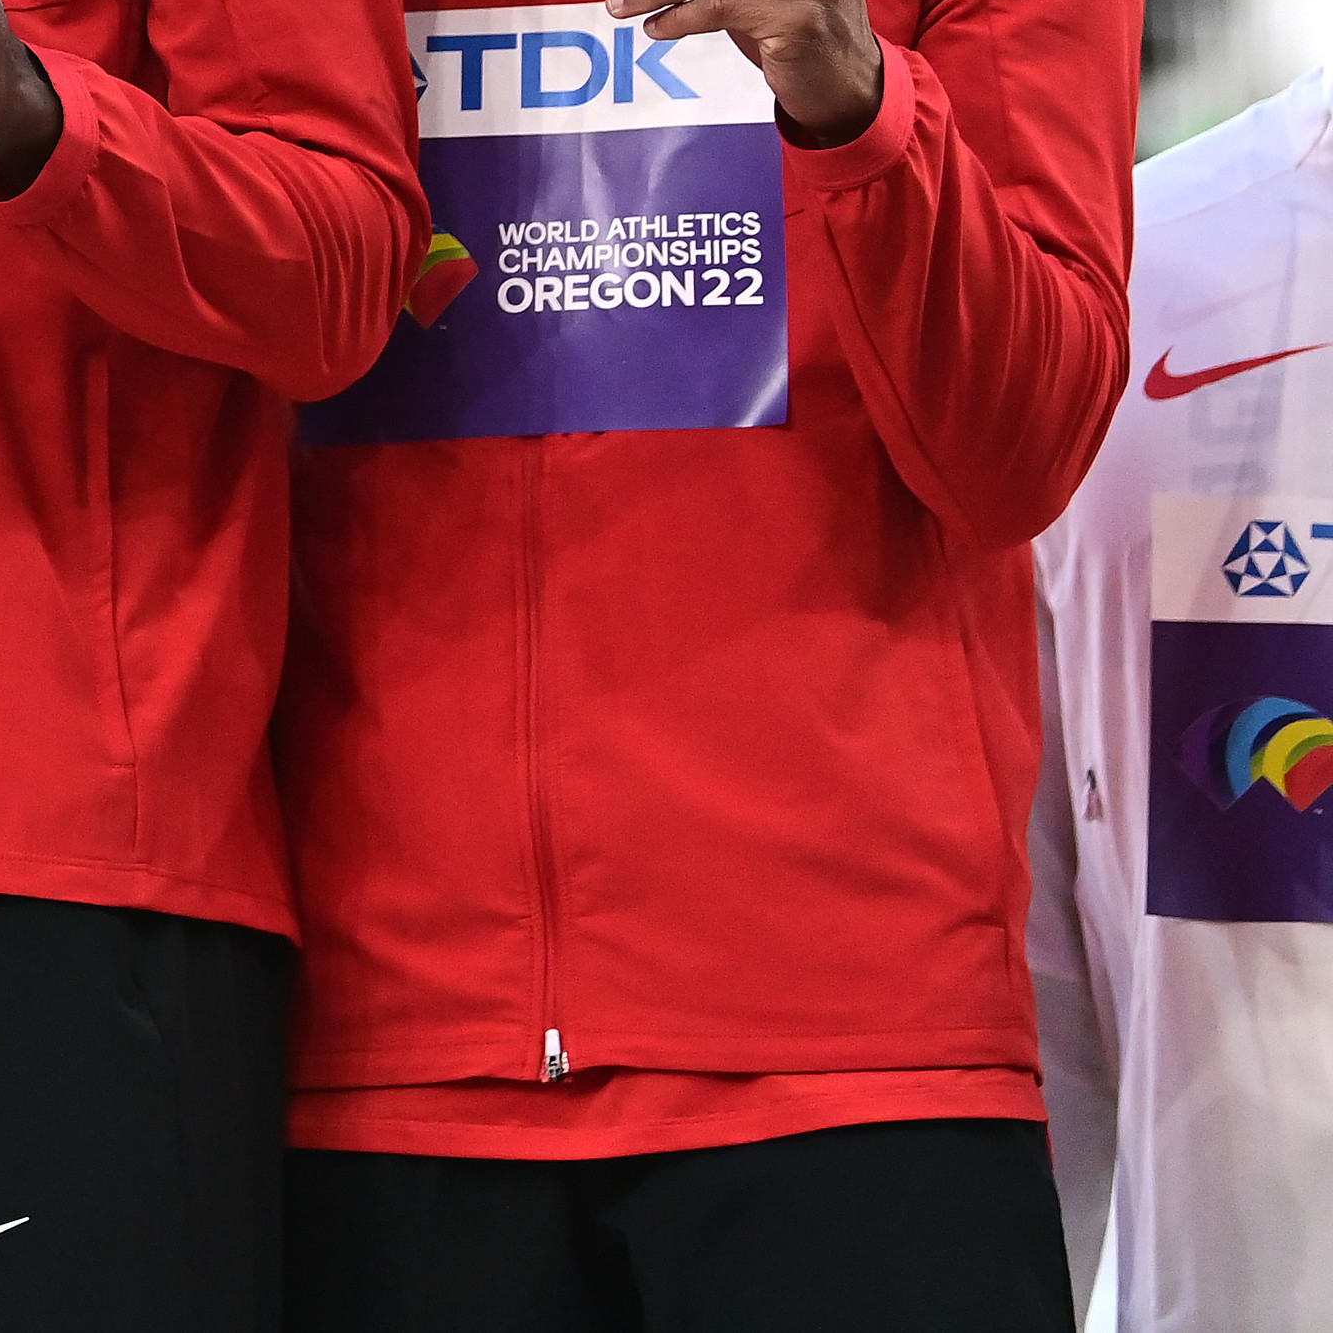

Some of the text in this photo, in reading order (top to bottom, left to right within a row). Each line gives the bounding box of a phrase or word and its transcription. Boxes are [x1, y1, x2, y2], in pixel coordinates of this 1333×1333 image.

[427, 27, 702, 111] TDK
[498, 211, 761, 246] WORLD ATHLETICS
[498, 239, 762, 274] CHAMPIONSHIPS
[497, 268, 764, 314] OREGON22
